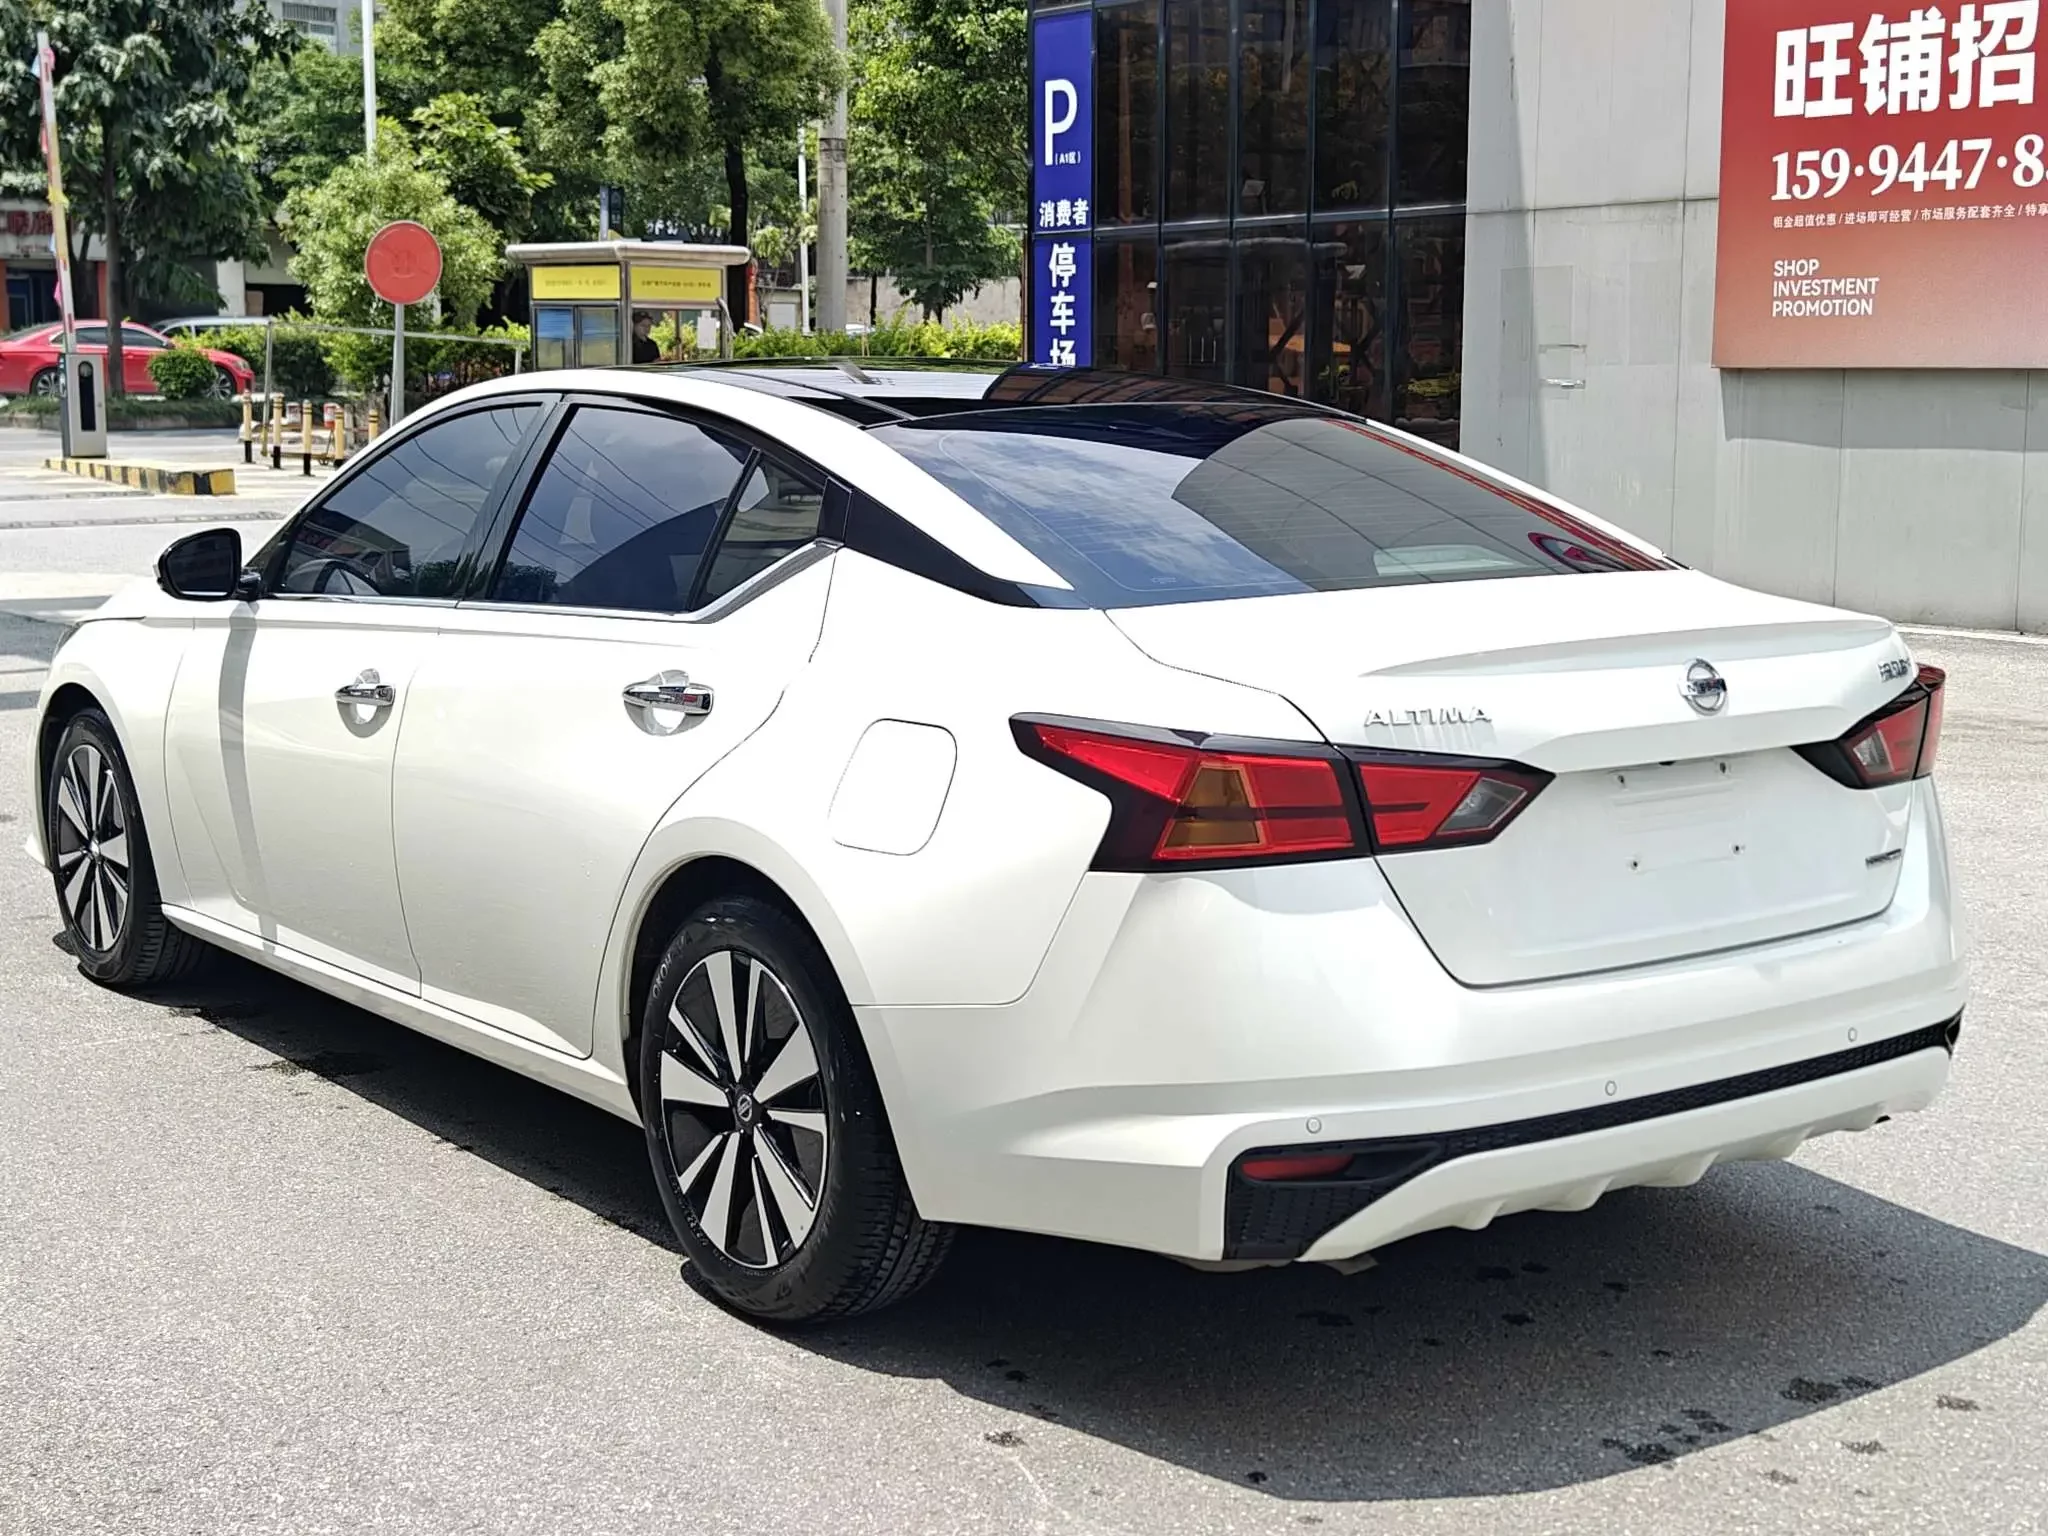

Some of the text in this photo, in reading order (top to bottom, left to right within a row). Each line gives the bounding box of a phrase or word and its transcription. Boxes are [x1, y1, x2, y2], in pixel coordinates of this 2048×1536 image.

[1774, 0, 2040, 118] 旺铺招
[1045, 79, 1078, 166] P
[1770, 134, 2048, 200] 159·9447·8
[1039, 197, 1089, 228] 消费者
[1773, 259, 1820, 277] SHOP
[1773, 277, 1880, 297] INVESTMENT
[1049, 242, 1077, 367] 停车场
[1772, 298, 1874, 317] PROMOTION
[1363, 705, 1493, 727] ALTIMA
